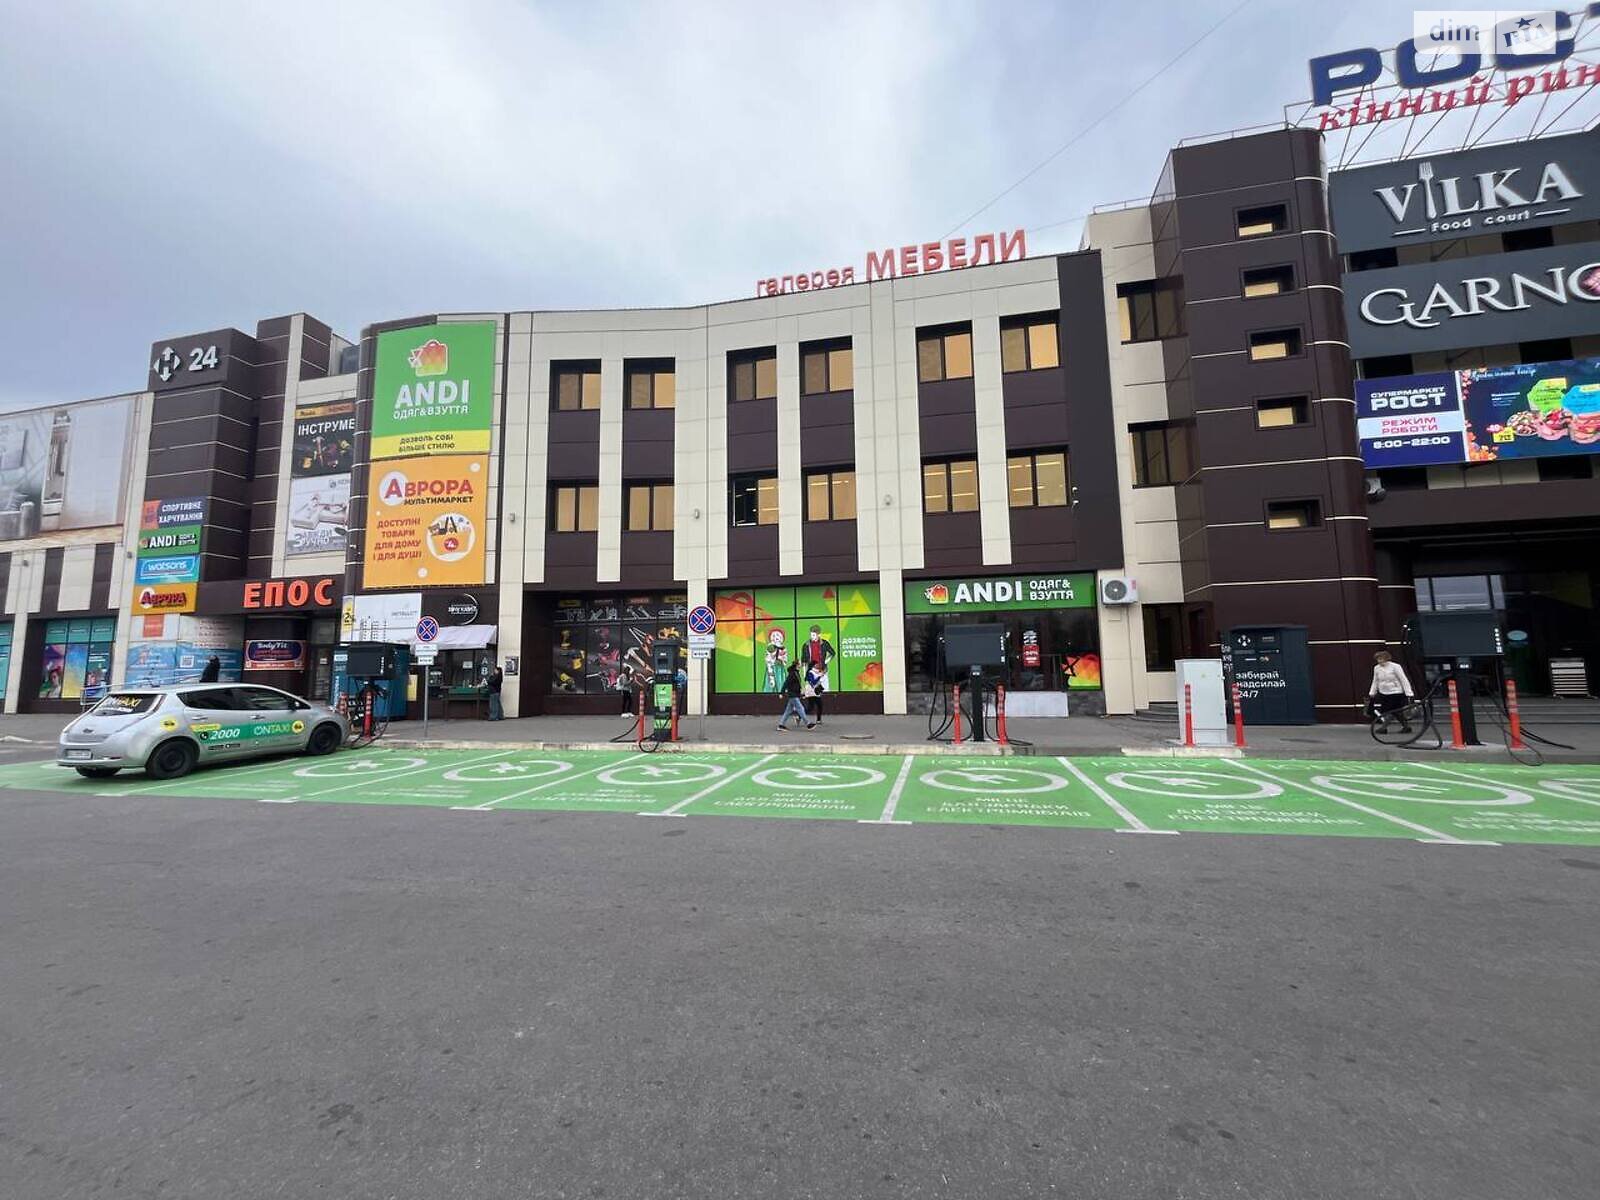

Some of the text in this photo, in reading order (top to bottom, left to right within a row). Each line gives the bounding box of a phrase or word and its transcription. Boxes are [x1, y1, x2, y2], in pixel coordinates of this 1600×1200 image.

[1318, 74, 1494, 131] кінний
[1373, 161, 1585, 223] VILKA
[1430, 209, 1531, 233] Food court
[756, 228, 1027, 297] галерея МЕБЕЛИ
[188, 345, 219, 372] 24
[394, 379, 470, 409] ANDI
[1370, 386, 1445, 399] СУПЕРМАРКЕТ
[1371, 392, 1447, 412] РОСТ
[298, 417, 356, 437] ІНСТРУМЕ
[1382, 416, 1436, 427] РЕЖИМ
[1382, 424, 1438, 435] РОБОТИ
[435, 433, 454, 442] СОБІ
[427, 442, 456, 450] СТИЛЮ
[403, 495, 474, 506] МУЛЬТИМАРКЕТ
[377, 517, 421, 529] ДОСТУПНІ
[381, 530, 416, 539] ТОВАРИ
[149, 535, 177, 548] ANDI
[374, 539, 422, 551] ДЛЯ ДОМУ
[377, 552, 397, 561] ДЛЯ
[1029, 579, 1071, 590] ОДЯГ&
[243, 578, 335, 609] ЕПОС
[953, 579, 1023, 604] ANDI
[1029, 590, 1074, 601] ВЗУТТЯ
[842, 649, 877, 658] СТИЛЮ
[1235, 671, 1280, 680] забирай
[1239, 690, 1259, 698] 24/7
[209, 728, 241, 740] 2000
